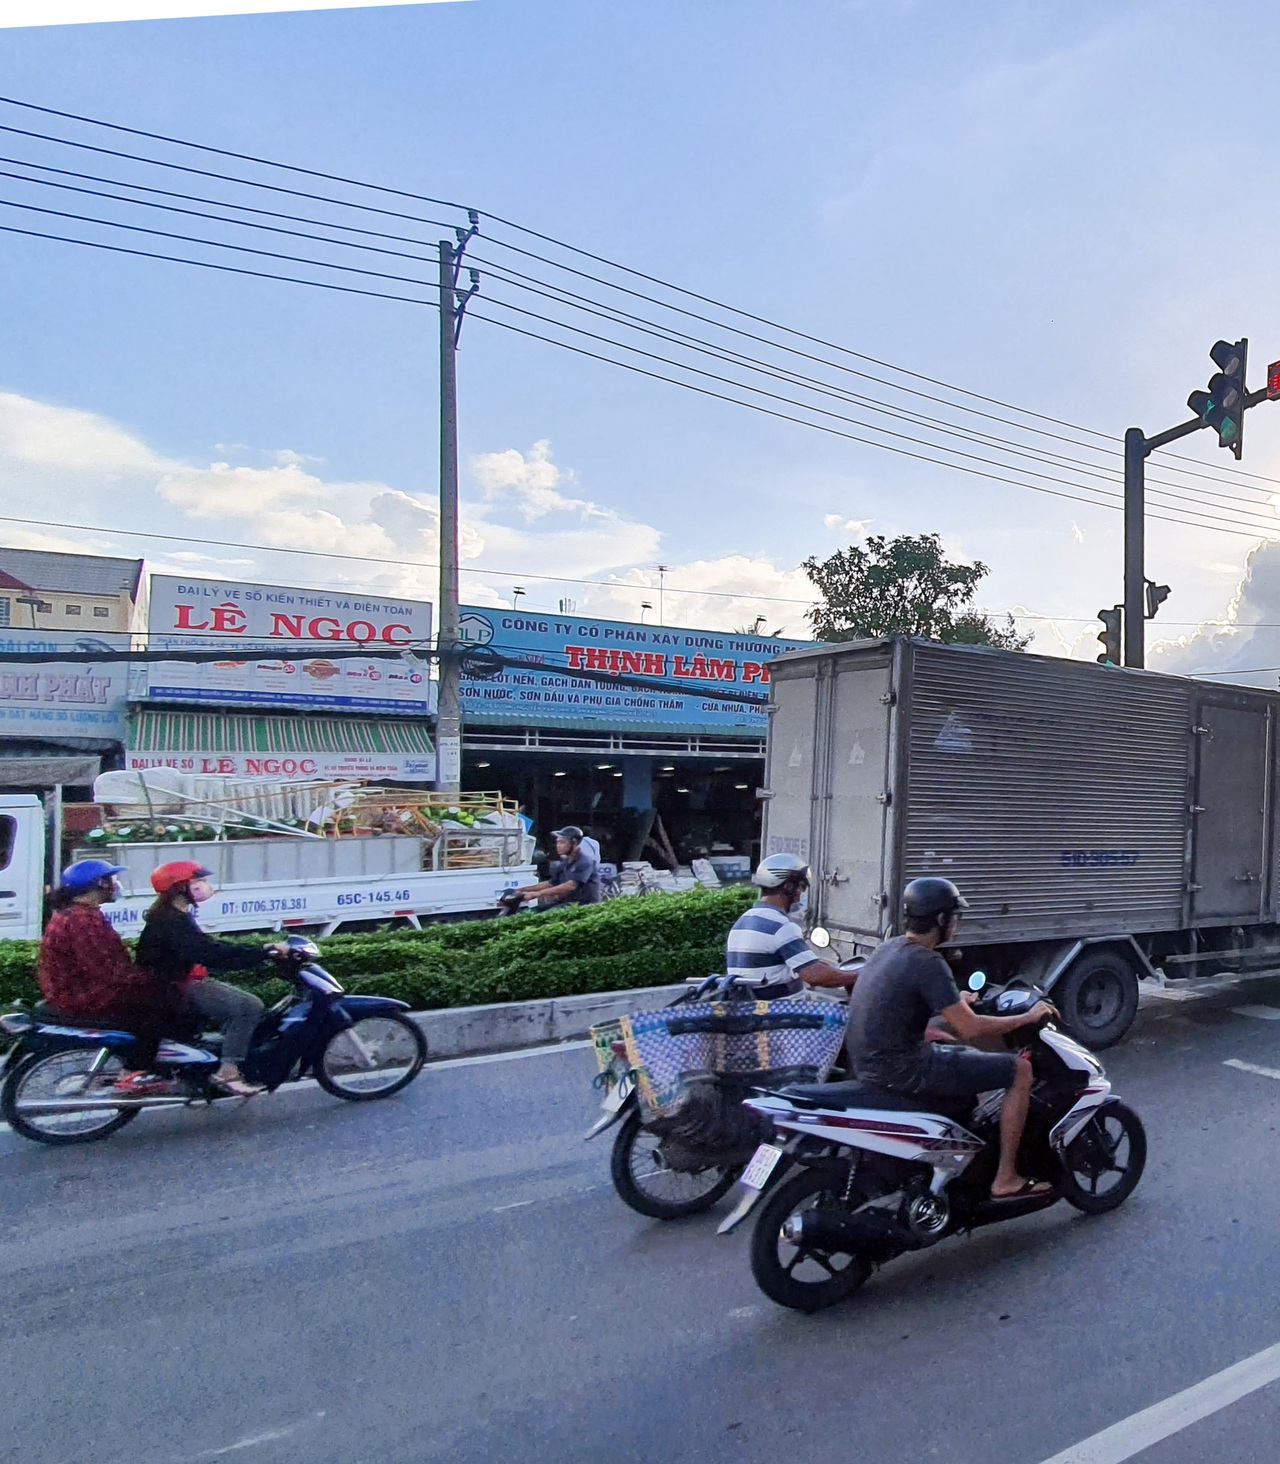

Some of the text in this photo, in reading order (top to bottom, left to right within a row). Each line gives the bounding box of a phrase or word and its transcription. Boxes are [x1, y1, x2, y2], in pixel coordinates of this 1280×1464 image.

[174, 601, 413, 649] LÊ NGỌC
[501, 616, 549, 633] CÔNG
[554, 622, 573, 635] TY
[578, 623, 600, 638] CỔ
[604, 627, 647, 643] PHẦN
[652, 632, 681, 645] XÂY
[685, 636, 724, 651] DỰNG
[728, 640, 781, 654] THƯƠNG
[565, 645, 665, 677] THỊNH
[673, 653, 736, 681] LÂM
[541, 676, 568, 689] GẠCH
[520, 689, 543, 701] SƠN
[583, 694, 602, 707] PHỤ
[605, 696, 622, 706] GIA
[624, 695, 656, 709] CHỐNG
[201, 755, 238, 774] LÊ
[245, 757, 318, 778] NGỌC
[241, 898, 307, 914] 0706.378.381
[337, 889, 410, 906] 65C-145.46
